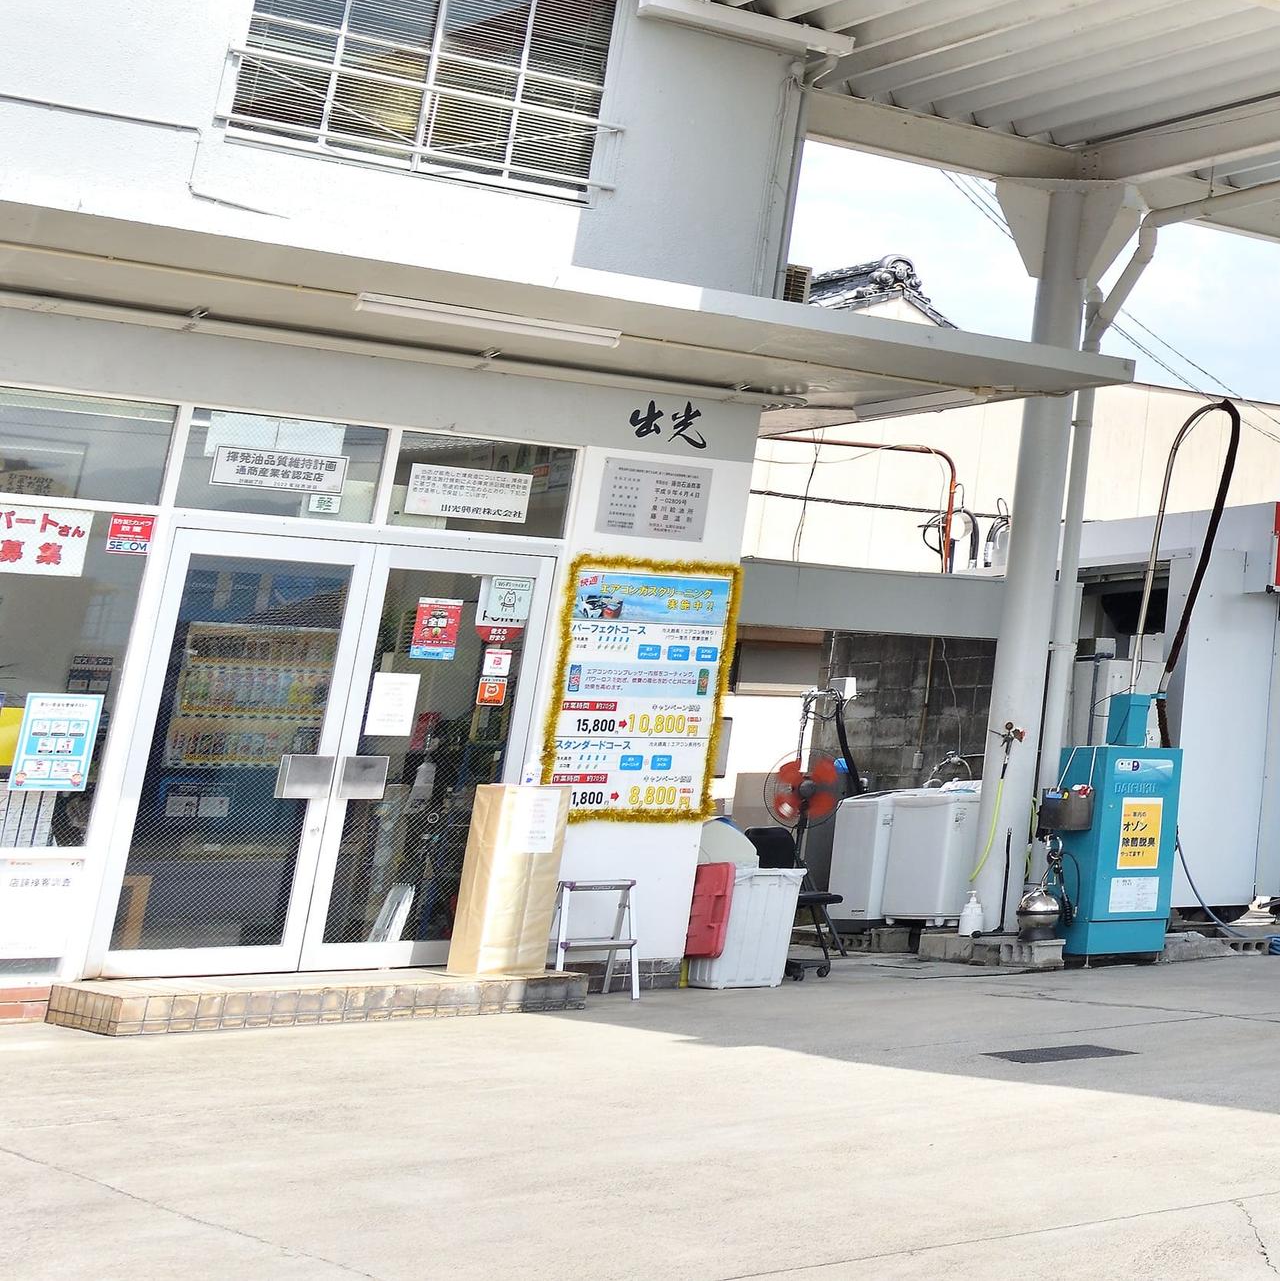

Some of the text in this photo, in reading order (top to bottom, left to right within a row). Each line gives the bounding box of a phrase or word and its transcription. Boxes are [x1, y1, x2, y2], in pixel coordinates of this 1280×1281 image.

[630, 400, 706, 449] 出光
[0, 540, 62, 565] 募集
[108, 541, 147, 551] SECOM
[572, 624, 646, 635] パーフェクトコース
[577, 719, 616, 734] 15,800
[629, 714, 685, 735] 10,800
[629, 786, 677, 807] 8,800
[1123, 821, 1147, 831] オゾン
[1121, 837, 1155, 847] 除菌脱臭
